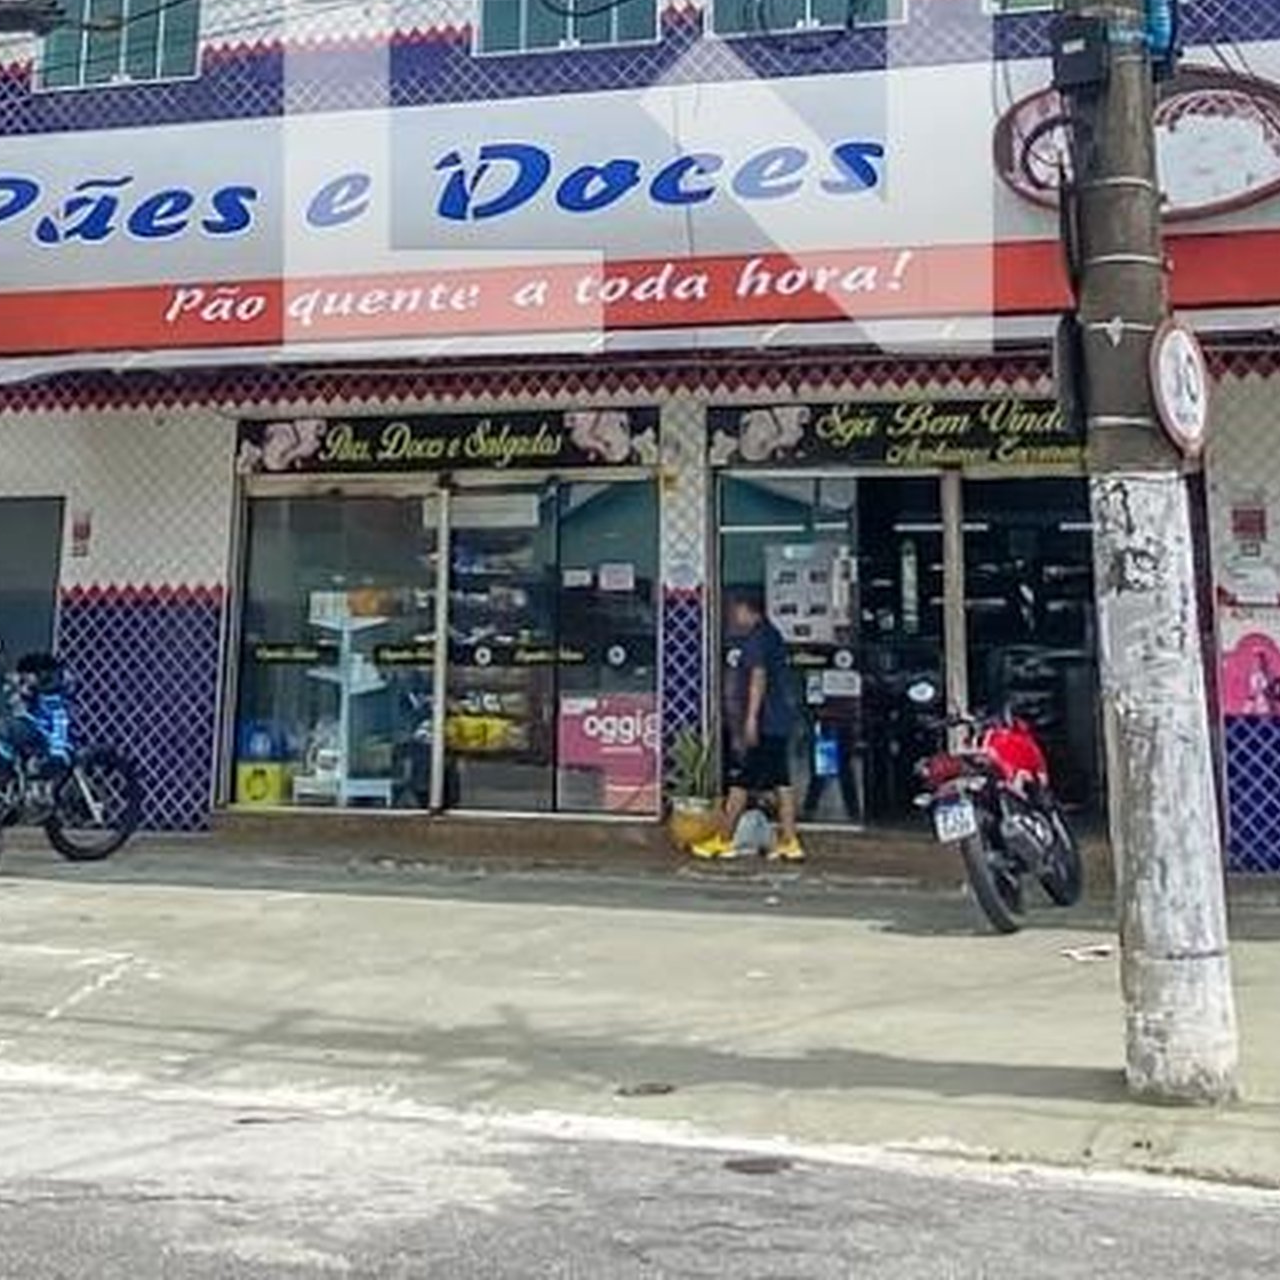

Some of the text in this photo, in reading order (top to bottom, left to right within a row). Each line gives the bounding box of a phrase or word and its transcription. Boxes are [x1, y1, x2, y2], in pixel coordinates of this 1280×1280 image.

[304, 171, 373, 228] e
[433, 139, 886, 222] Doces
[164, 250, 913, 326] Pão quente a toda hora!
[885, 400, 970, 437] Bem
